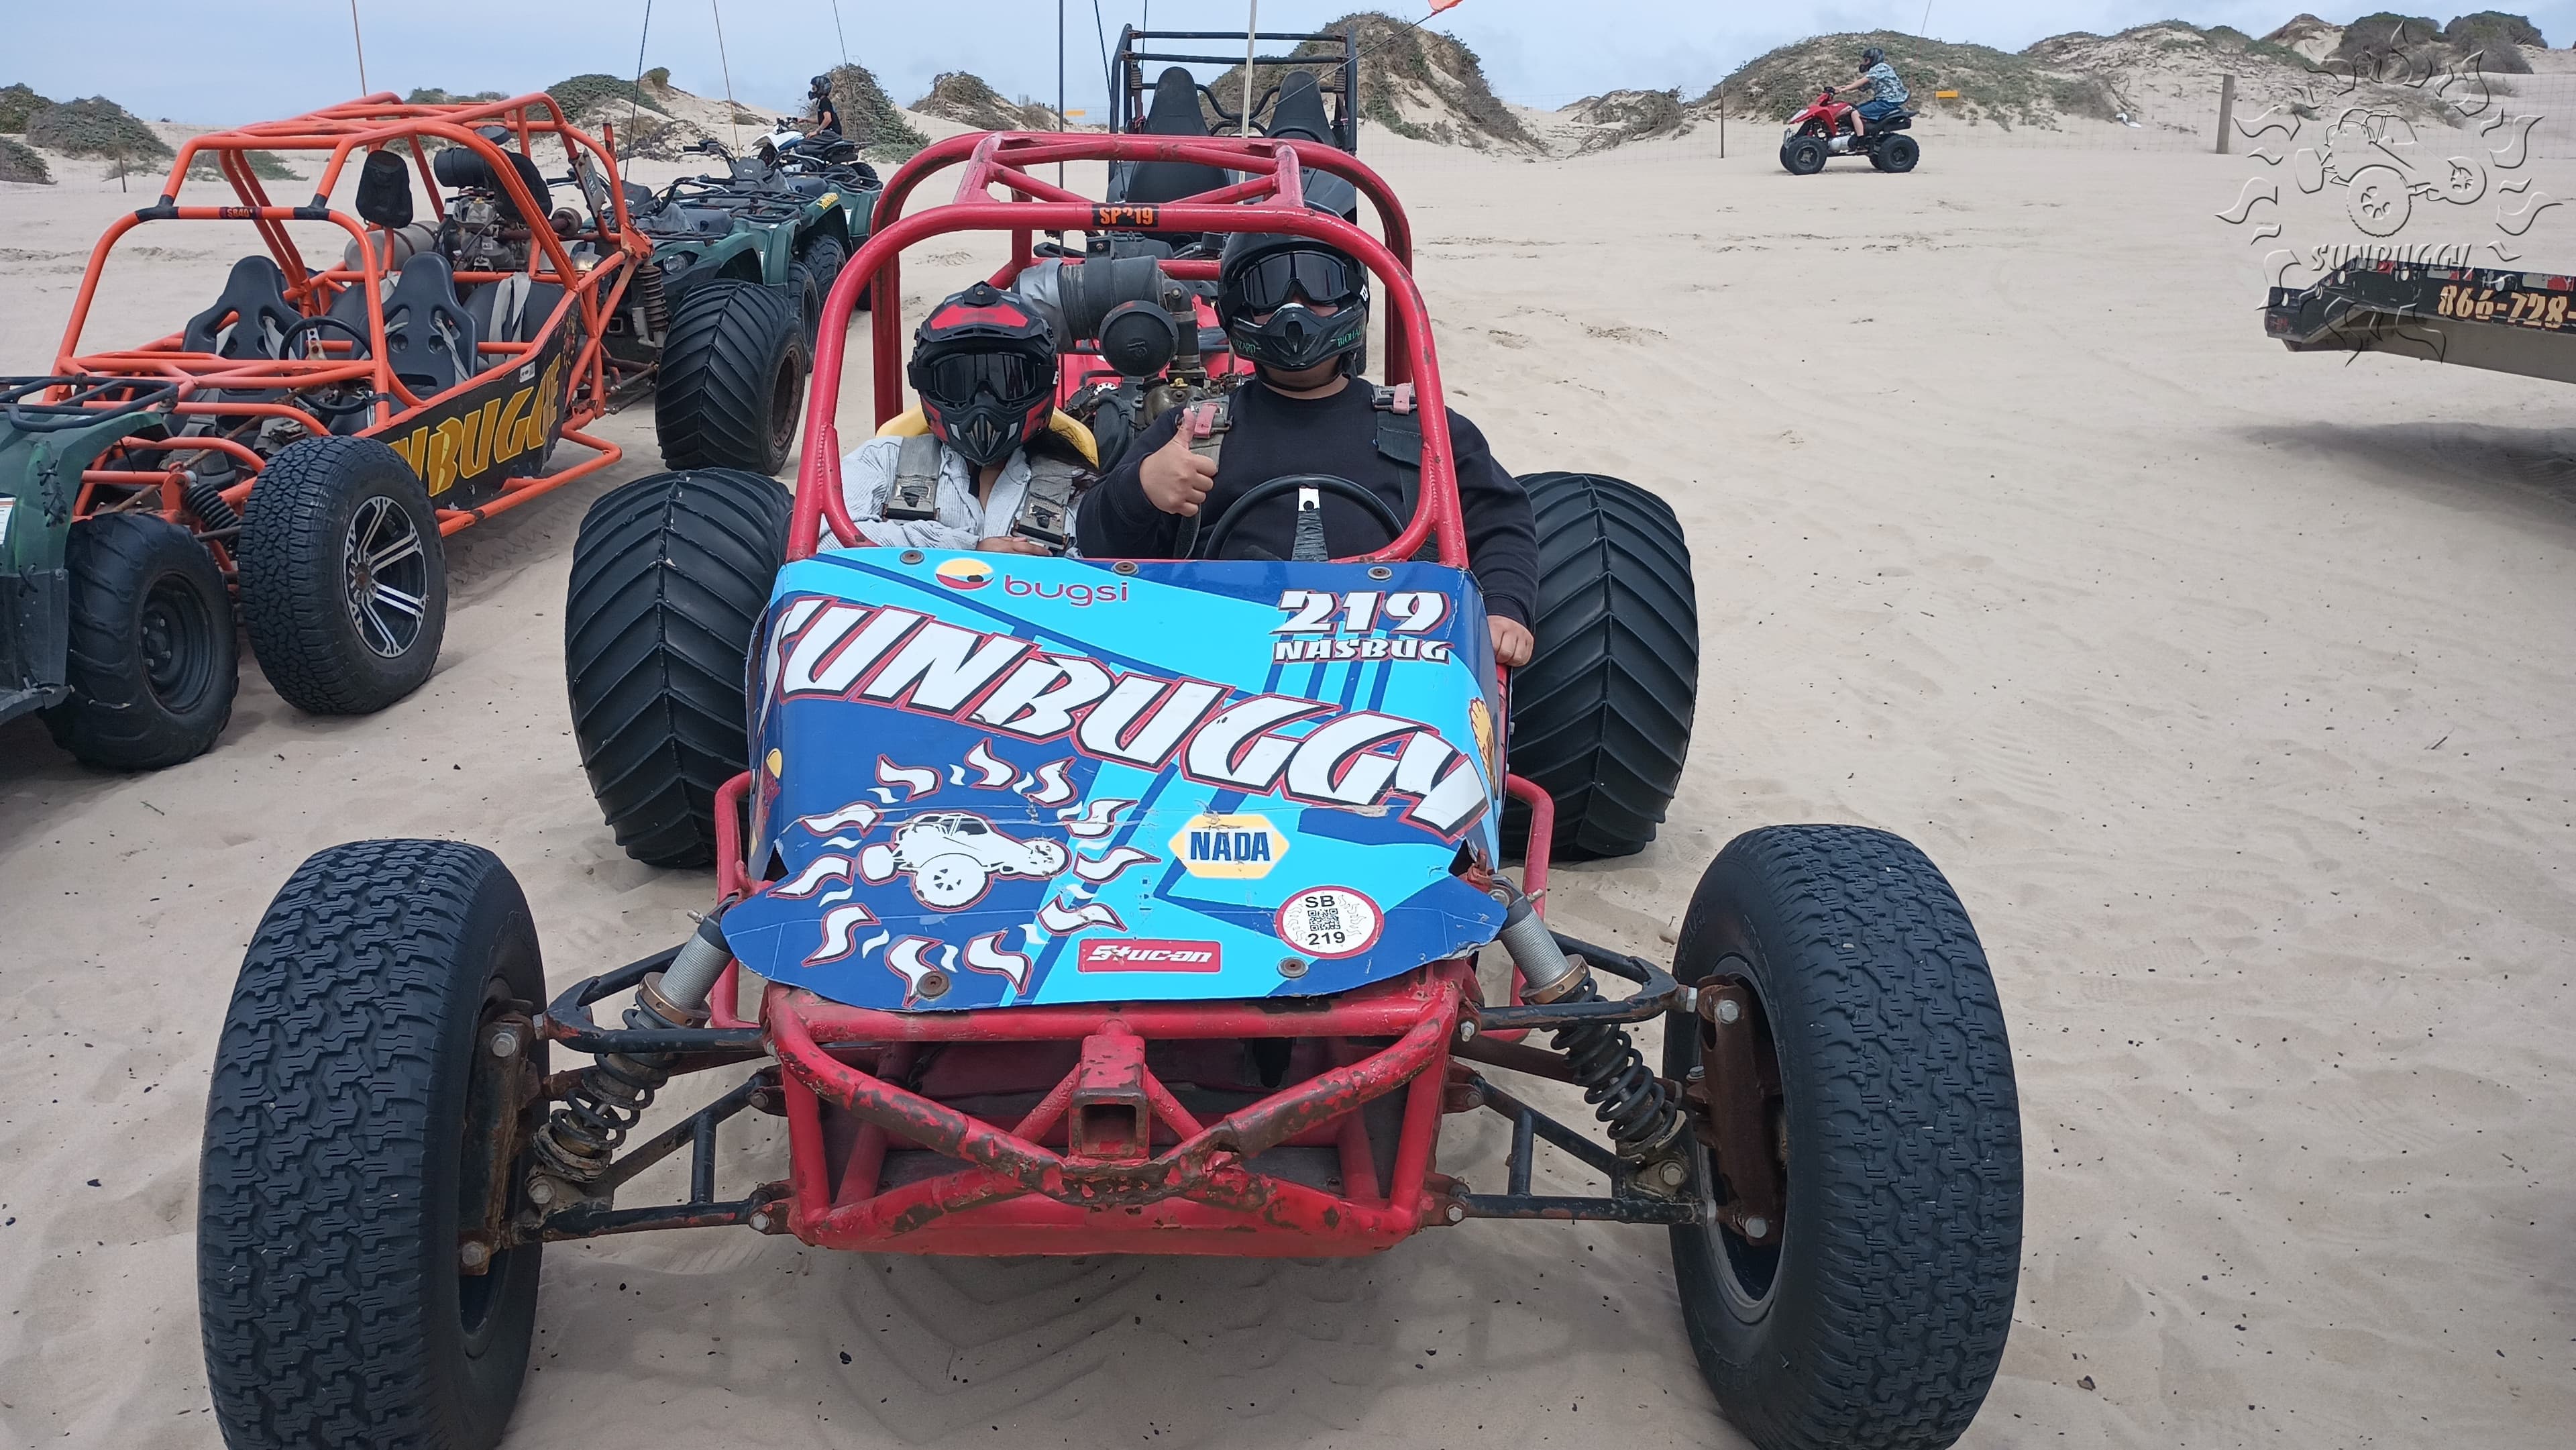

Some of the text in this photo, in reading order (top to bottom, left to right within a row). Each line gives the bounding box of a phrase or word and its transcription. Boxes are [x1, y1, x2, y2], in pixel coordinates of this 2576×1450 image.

[1005, 574, 1128, 607] bugsi
[1268, 589, 1451, 634] 219
[1273, 637, 1455, 666] NASBUG
[1190, 831, 1270, 861] NADA
[1305, 895, 1336, 908] SB
[1308, 931, 1346, 945] 219
